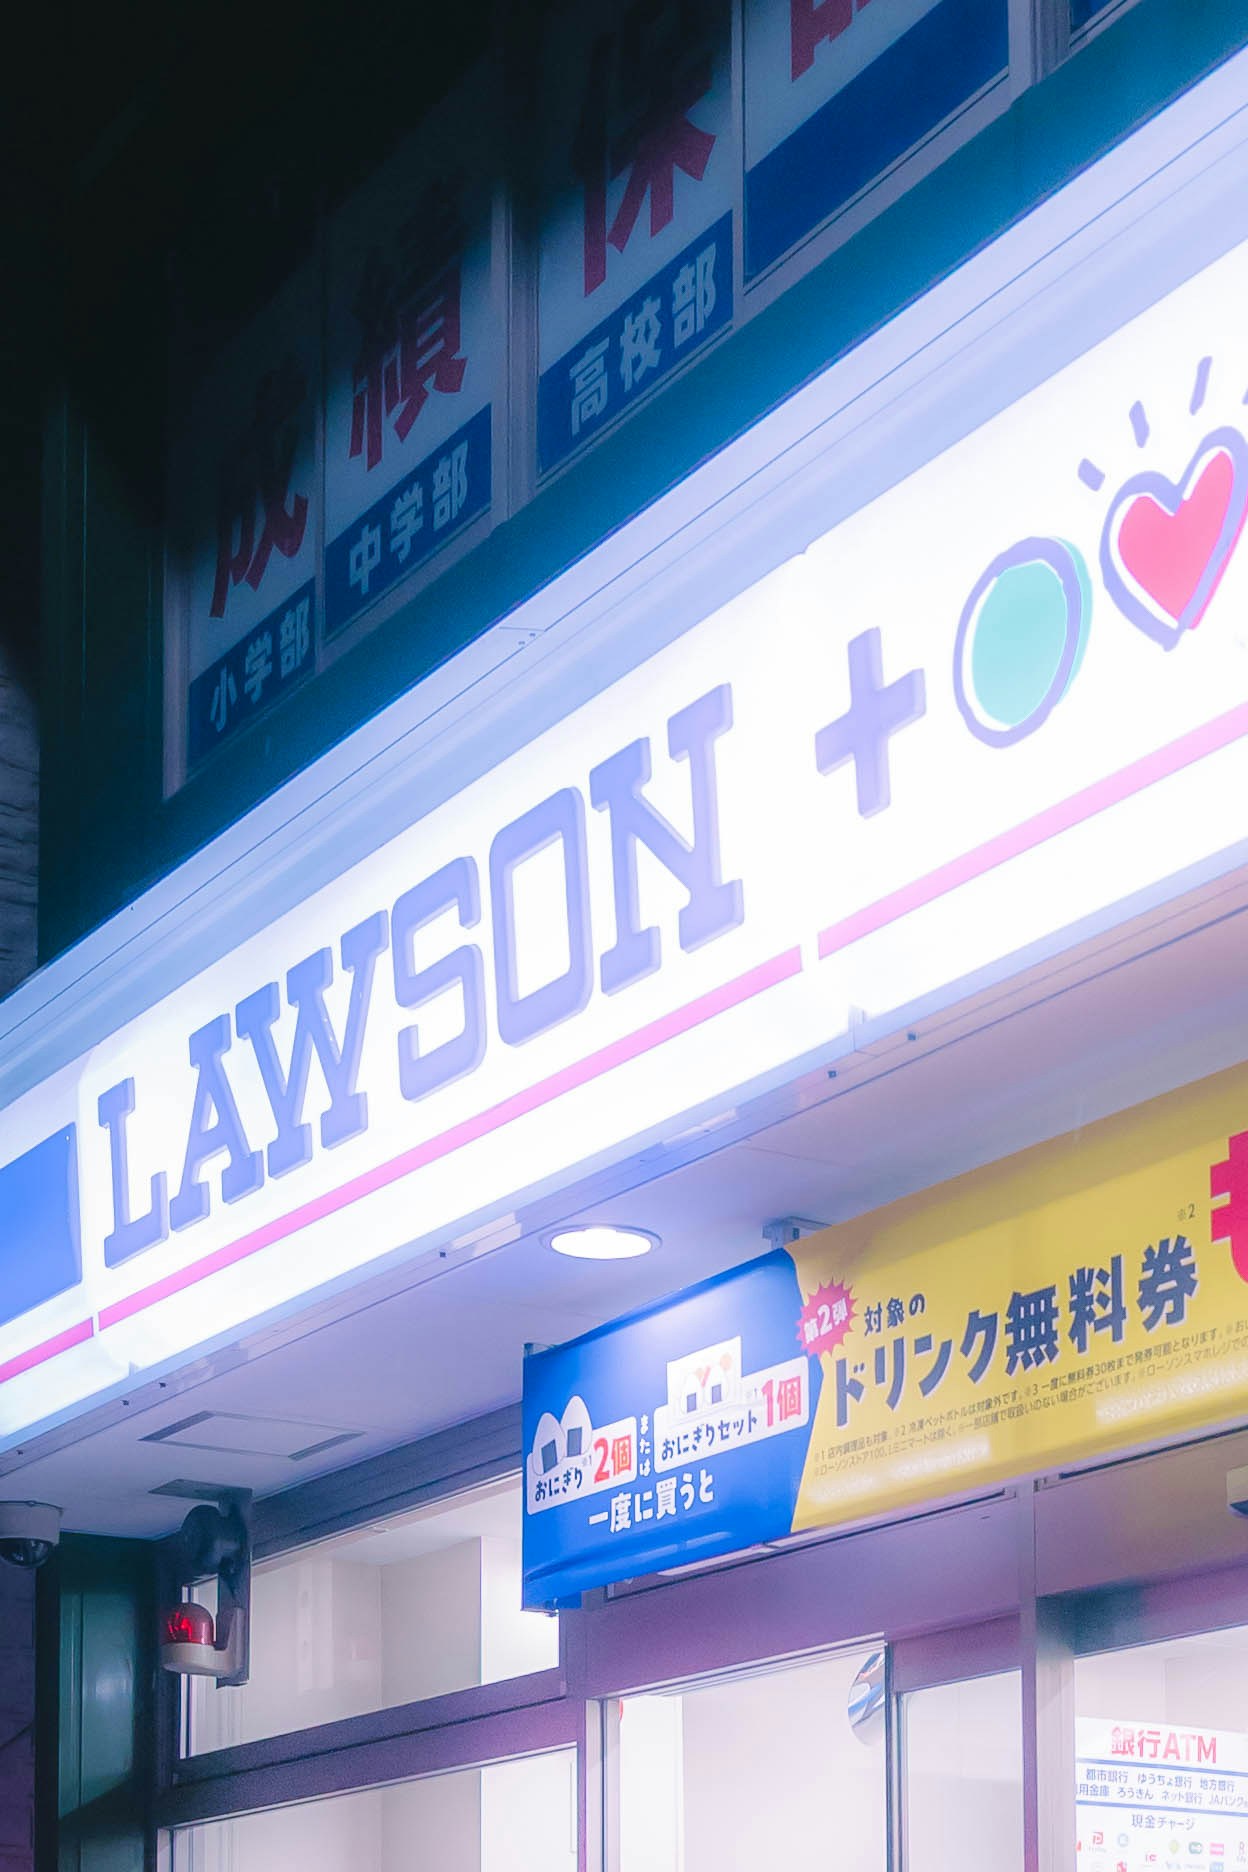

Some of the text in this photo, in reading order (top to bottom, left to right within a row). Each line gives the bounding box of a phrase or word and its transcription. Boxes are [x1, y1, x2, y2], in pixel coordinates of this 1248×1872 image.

[567, 241, 719, 437] 高校部
[347, 440, 470, 596] 中学部
[208, 600, 311, 734] 小学部
[97, 683, 745, 1269] LAWSON
[836, 1233, 1200, 1428] ドリンク無料券
[863, 1293, 927, 1337] 対象の
[639, 1413, 652, 1477] または
[660, 1374, 803, 1462] おにぎりセット 1個
[534, 1434, 632, 1502] おにぎり 2個
[588, 1468, 715, 1534] 一度に買うと
[1110, 1725, 1218, 1764] 銀行ATM
[1075, 1782, 1111, 1798] 用金庫
[1131, 1813, 1196, 1831] 現金チャージ
